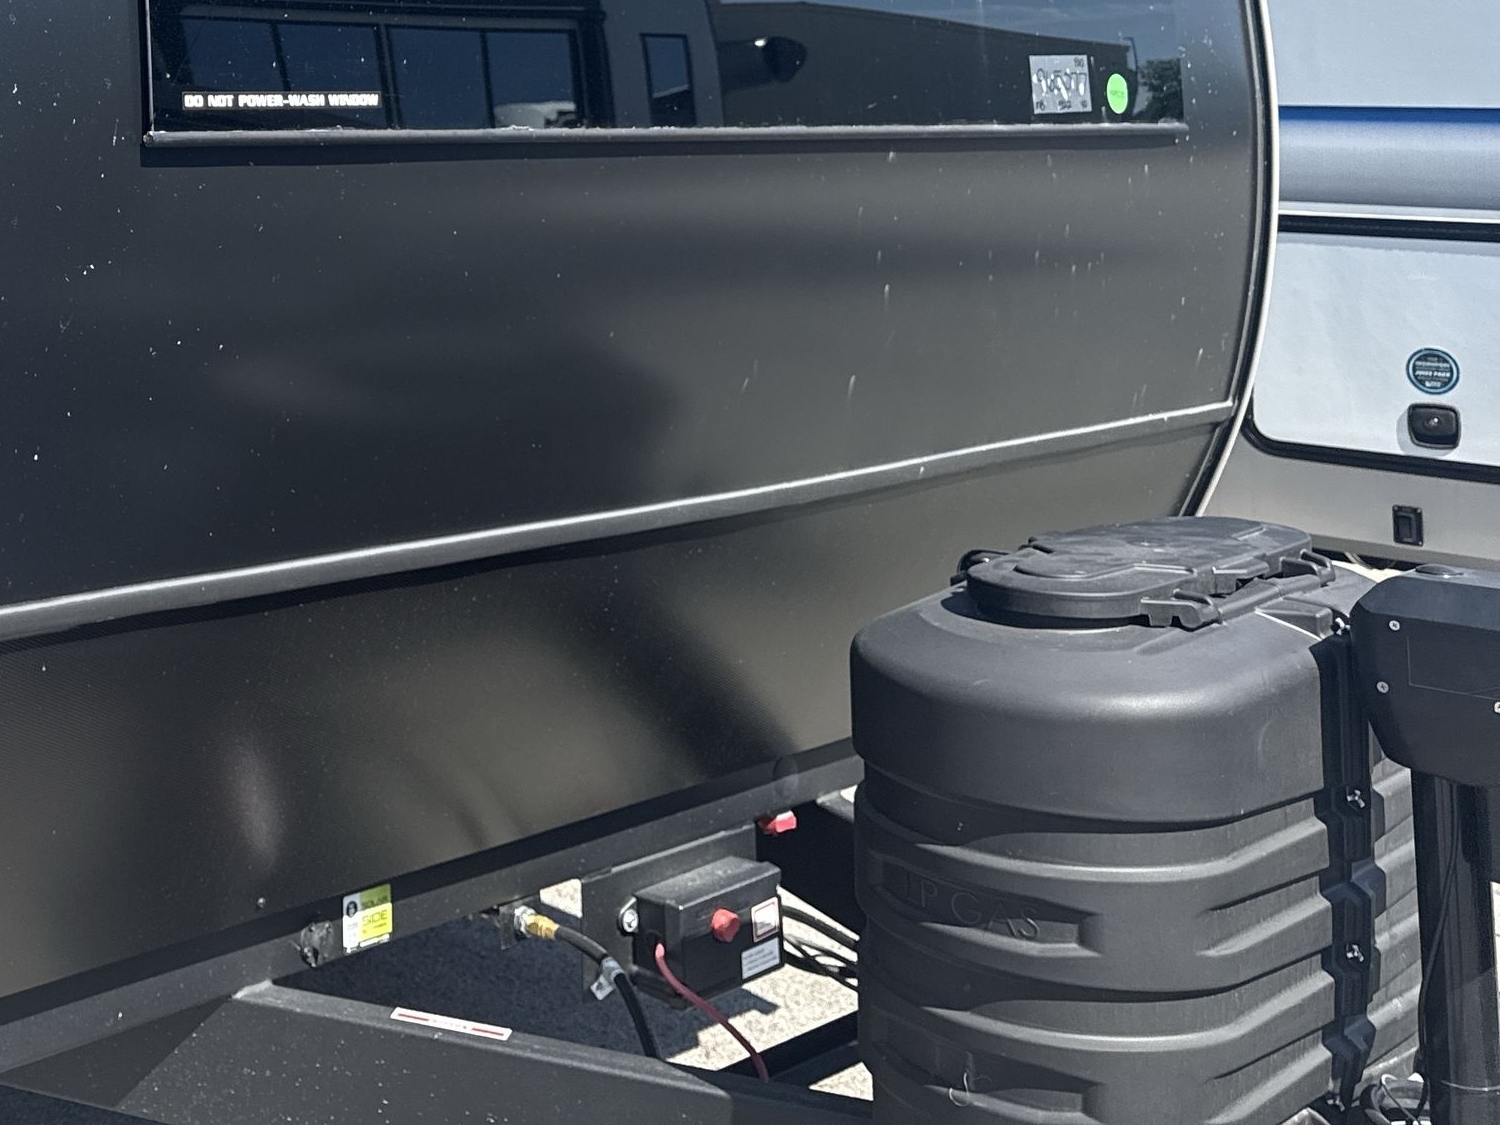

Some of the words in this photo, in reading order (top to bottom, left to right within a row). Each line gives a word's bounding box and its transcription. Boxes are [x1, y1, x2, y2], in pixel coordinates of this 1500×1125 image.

[184, 93, 204, 108] DO
[207, 93, 234, 108] NOT
[238, 93, 326, 108] POWER-WASH
[328, 93, 379, 107] WINDOW
